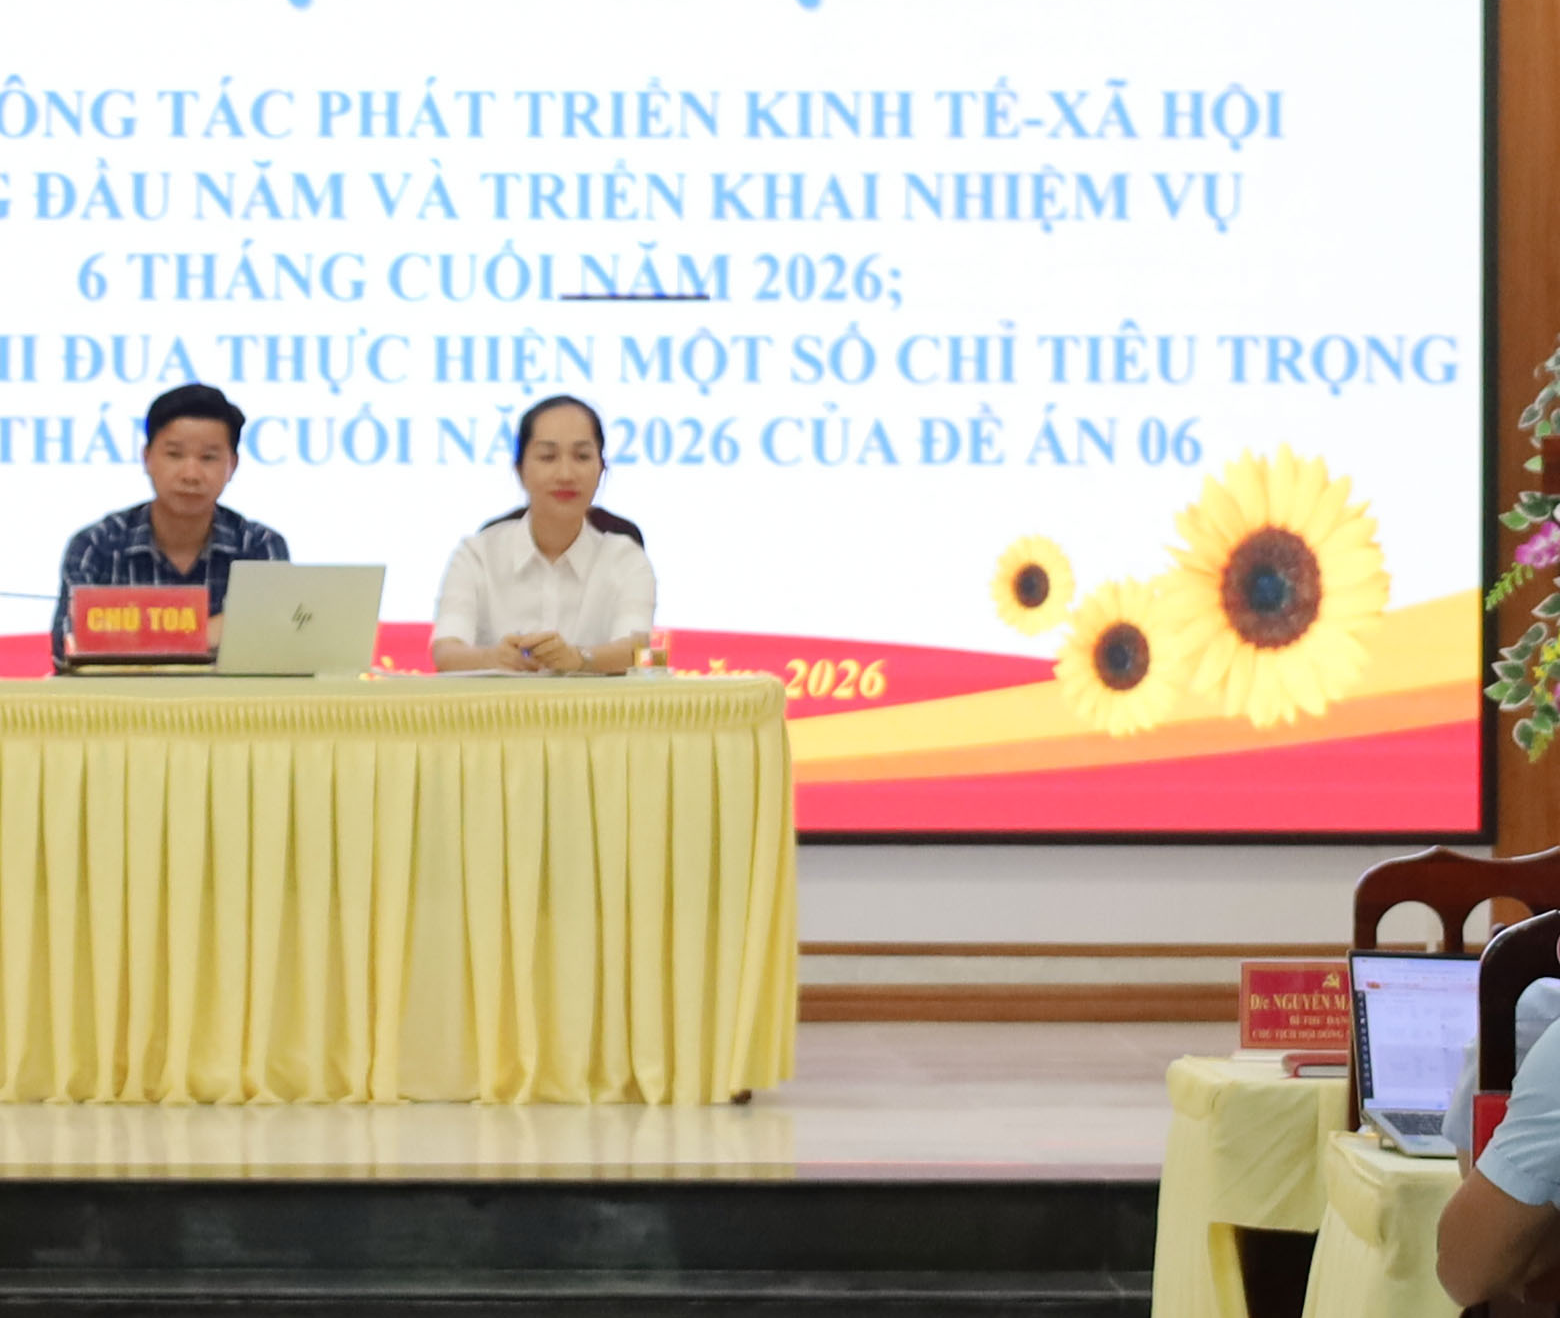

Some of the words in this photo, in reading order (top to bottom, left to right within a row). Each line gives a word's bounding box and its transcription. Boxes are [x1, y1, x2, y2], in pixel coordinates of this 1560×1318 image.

[158, 75, 294, 138] TÁC
[318, 76, 496, 138] PHÁT
[515, 77, 719, 139] TRIỂN
[746, 91, 913, 139] KINH
[935, 76, 1138, 139] TẾ-XÃ
[1163, 83, 1282, 152] HỘI
[77, 253, 108, 301] 6
[128, 238, 365, 302] THÁNG
[387, 238, 556, 303] CUỐI
[578, 239, 731, 303] NĂM
[755, 253, 902, 309] 2026;
[61, 334, 202, 383] ĐUA
[217, 326, 410, 396] THỰC
[433, 327, 594, 396] HIỆN
[620, 327, 774, 397] MỘT
[791, 321, 877, 384] SỐ
[896, 320, 1016, 384] CHỈ
[1038, 318, 1196, 384] TIÊU
[1218, 335, 1457, 397] TRỌNG
[246, 402, 413, 465] CUỐI
[437, 404, 512, 466] NĂ
[616, 417, 741, 467] 2026
[760, 401, 900, 467] CỦA
[917, 401, 1005, 466] ĐỀ
[1026, 402, 1116, 466] ÁN
[1138, 417, 1203, 467] 06
[87, 601, 141, 633] CHỦ
[784, 658, 887, 700] 2026
